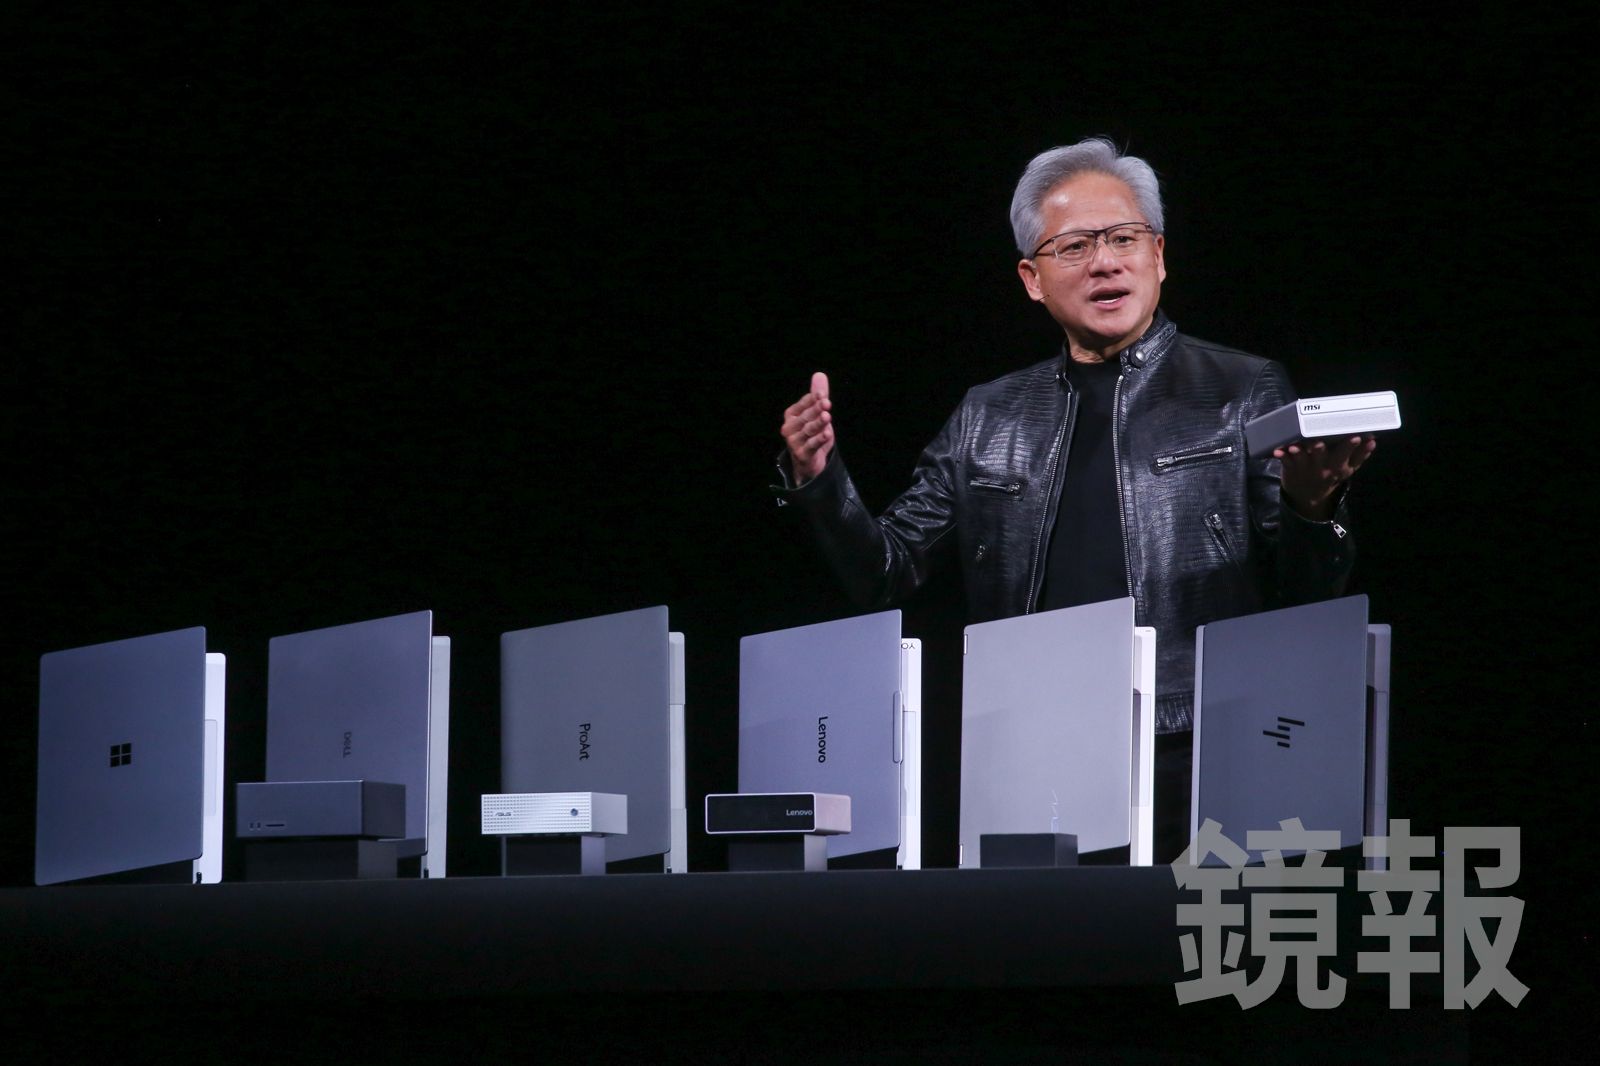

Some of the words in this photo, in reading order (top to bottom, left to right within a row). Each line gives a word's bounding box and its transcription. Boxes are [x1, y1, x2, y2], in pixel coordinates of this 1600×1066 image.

[343, 731, 352, 759] DELL
[579, 723, 591, 761] ProArt
[818, 716, 829, 763] Lenovo
